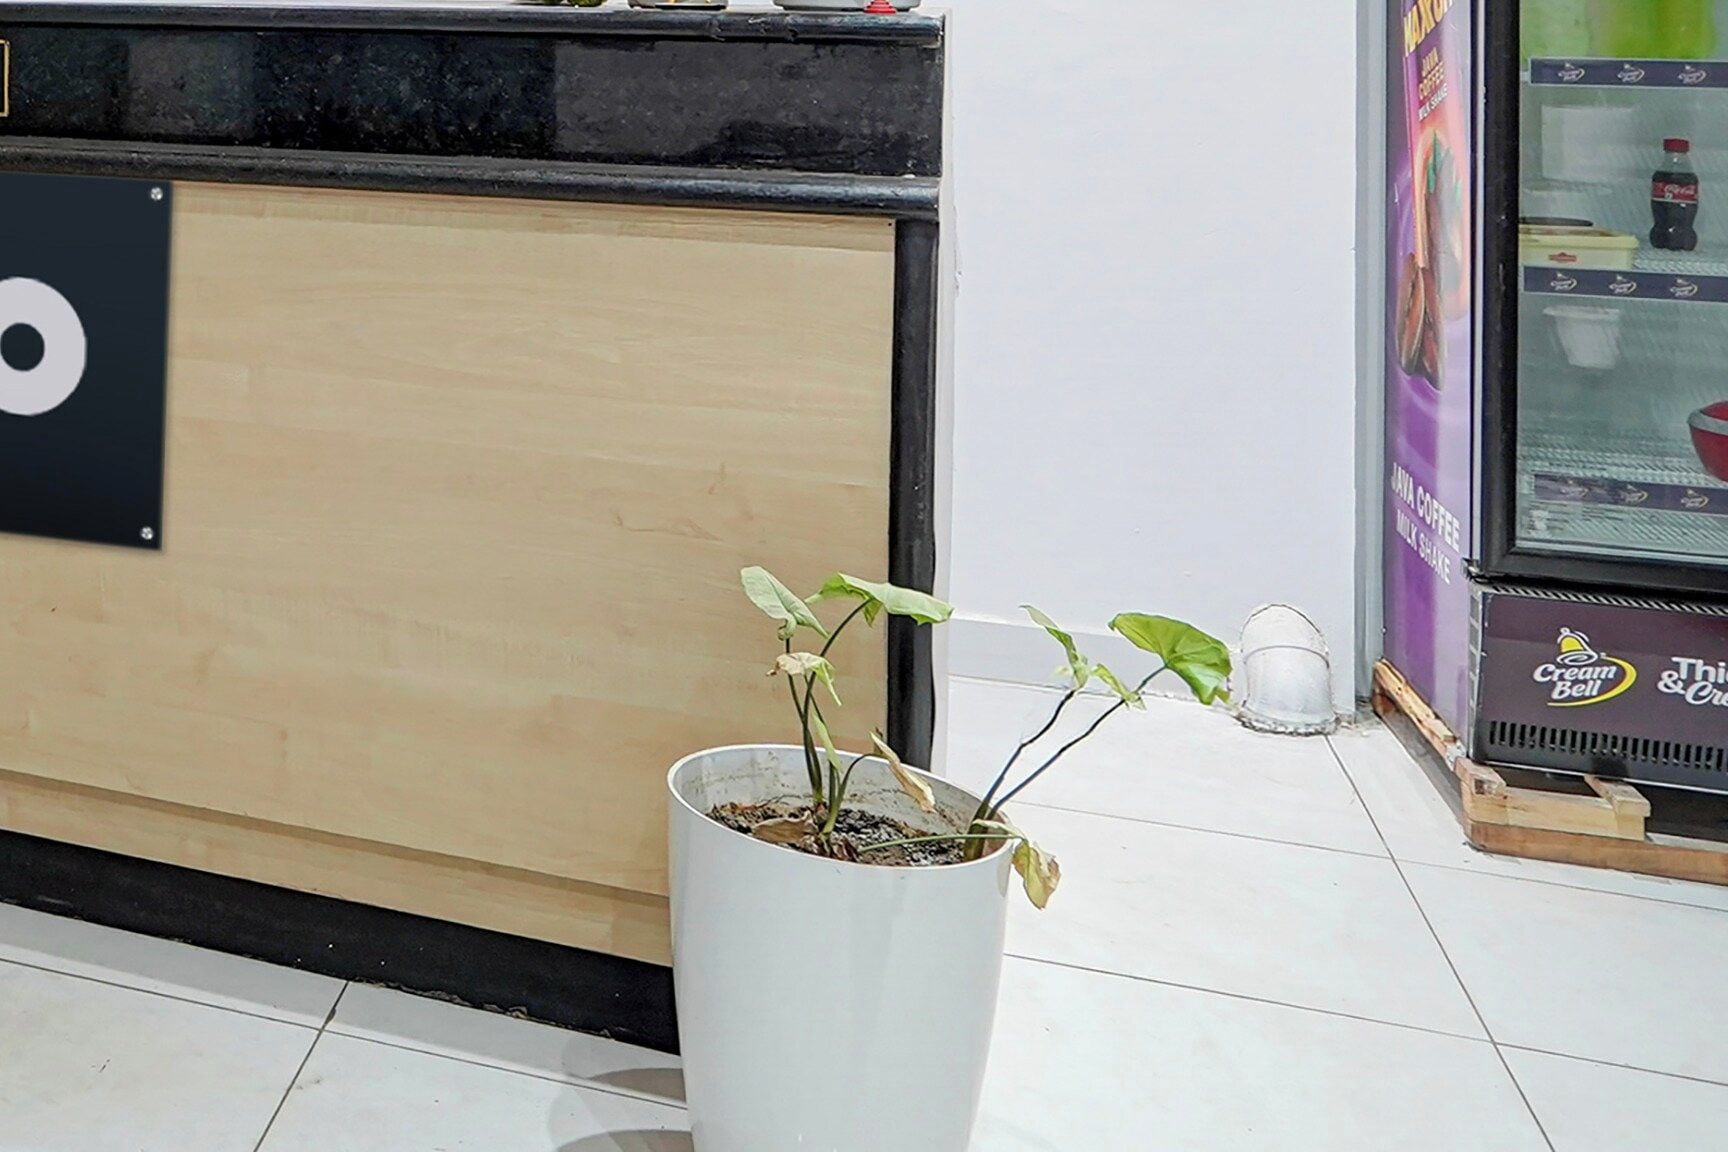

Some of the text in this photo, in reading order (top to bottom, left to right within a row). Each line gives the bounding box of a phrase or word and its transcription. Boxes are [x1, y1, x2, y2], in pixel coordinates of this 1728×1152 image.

[1391, 462, 1460, 553] JAVA COFFEE
[1396, 508, 1451, 585] MILK SHAKE
[1533, 663, 1618, 683] Cream
[1671, 656, 1728, 684] Thi
[1551, 679, 1602, 699] Bell
